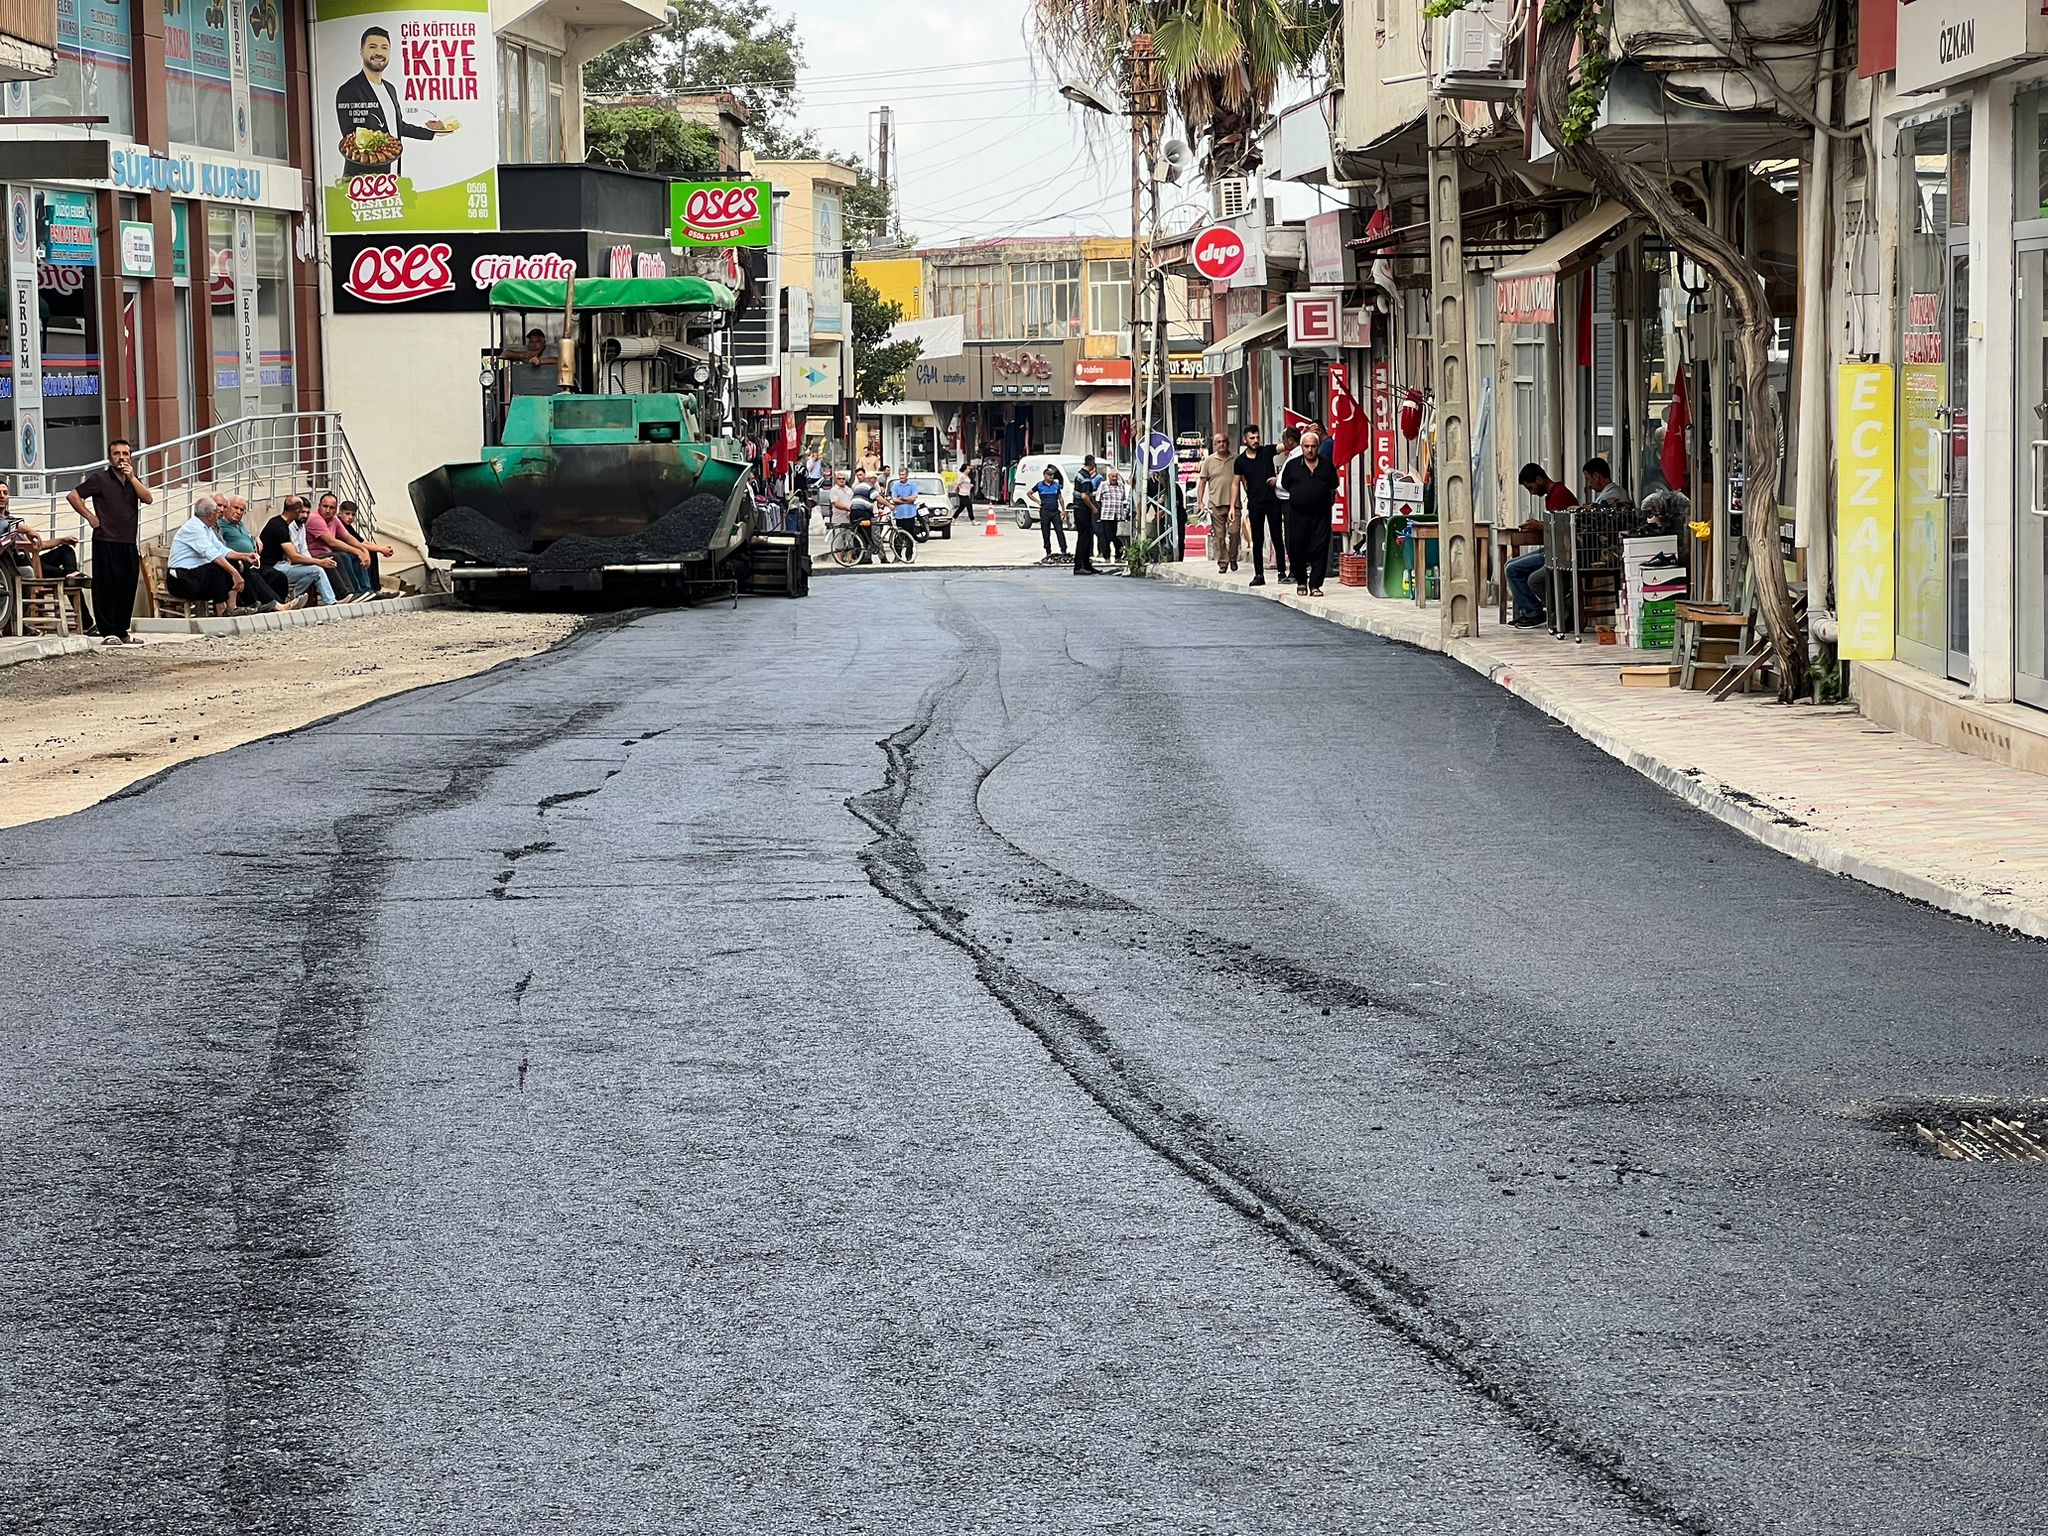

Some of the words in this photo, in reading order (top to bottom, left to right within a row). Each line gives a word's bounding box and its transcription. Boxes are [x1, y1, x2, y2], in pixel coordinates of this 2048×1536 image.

[232, 5, 242, 67] ERDEM
[401, 20, 420, 39] ÇİĞ
[423, 20, 476, 37] KÖFTELER
[1940, 18, 1975, 64] ÖZKAN
[402, 39, 478, 76] İKİYE
[404, 78, 478, 101] AYRILIR
[112, 147, 195, 194] SÜRÜCÜ
[200, 163, 261, 201] KURSU
[467, 183, 487, 193] 0506
[467, 194, 488, 207] 479
[351, 207, 404, 222] YESEK
[688, 229, 705, 240] 0506
[705, 231, 719, 240] 479
[720, 230, 730, 239] 56
[730, 229, 739, 237] 80
[1199, 243, 1240, 264] dyo
[19, 290, 30, 369] ERDEM
[243, 297, 252, 364] ERDEM
[1302, 305, 1329, 335] E
[1083, 364, 1104, 374] vodafone
[1849, 372, 1885, 649] ECZANE
